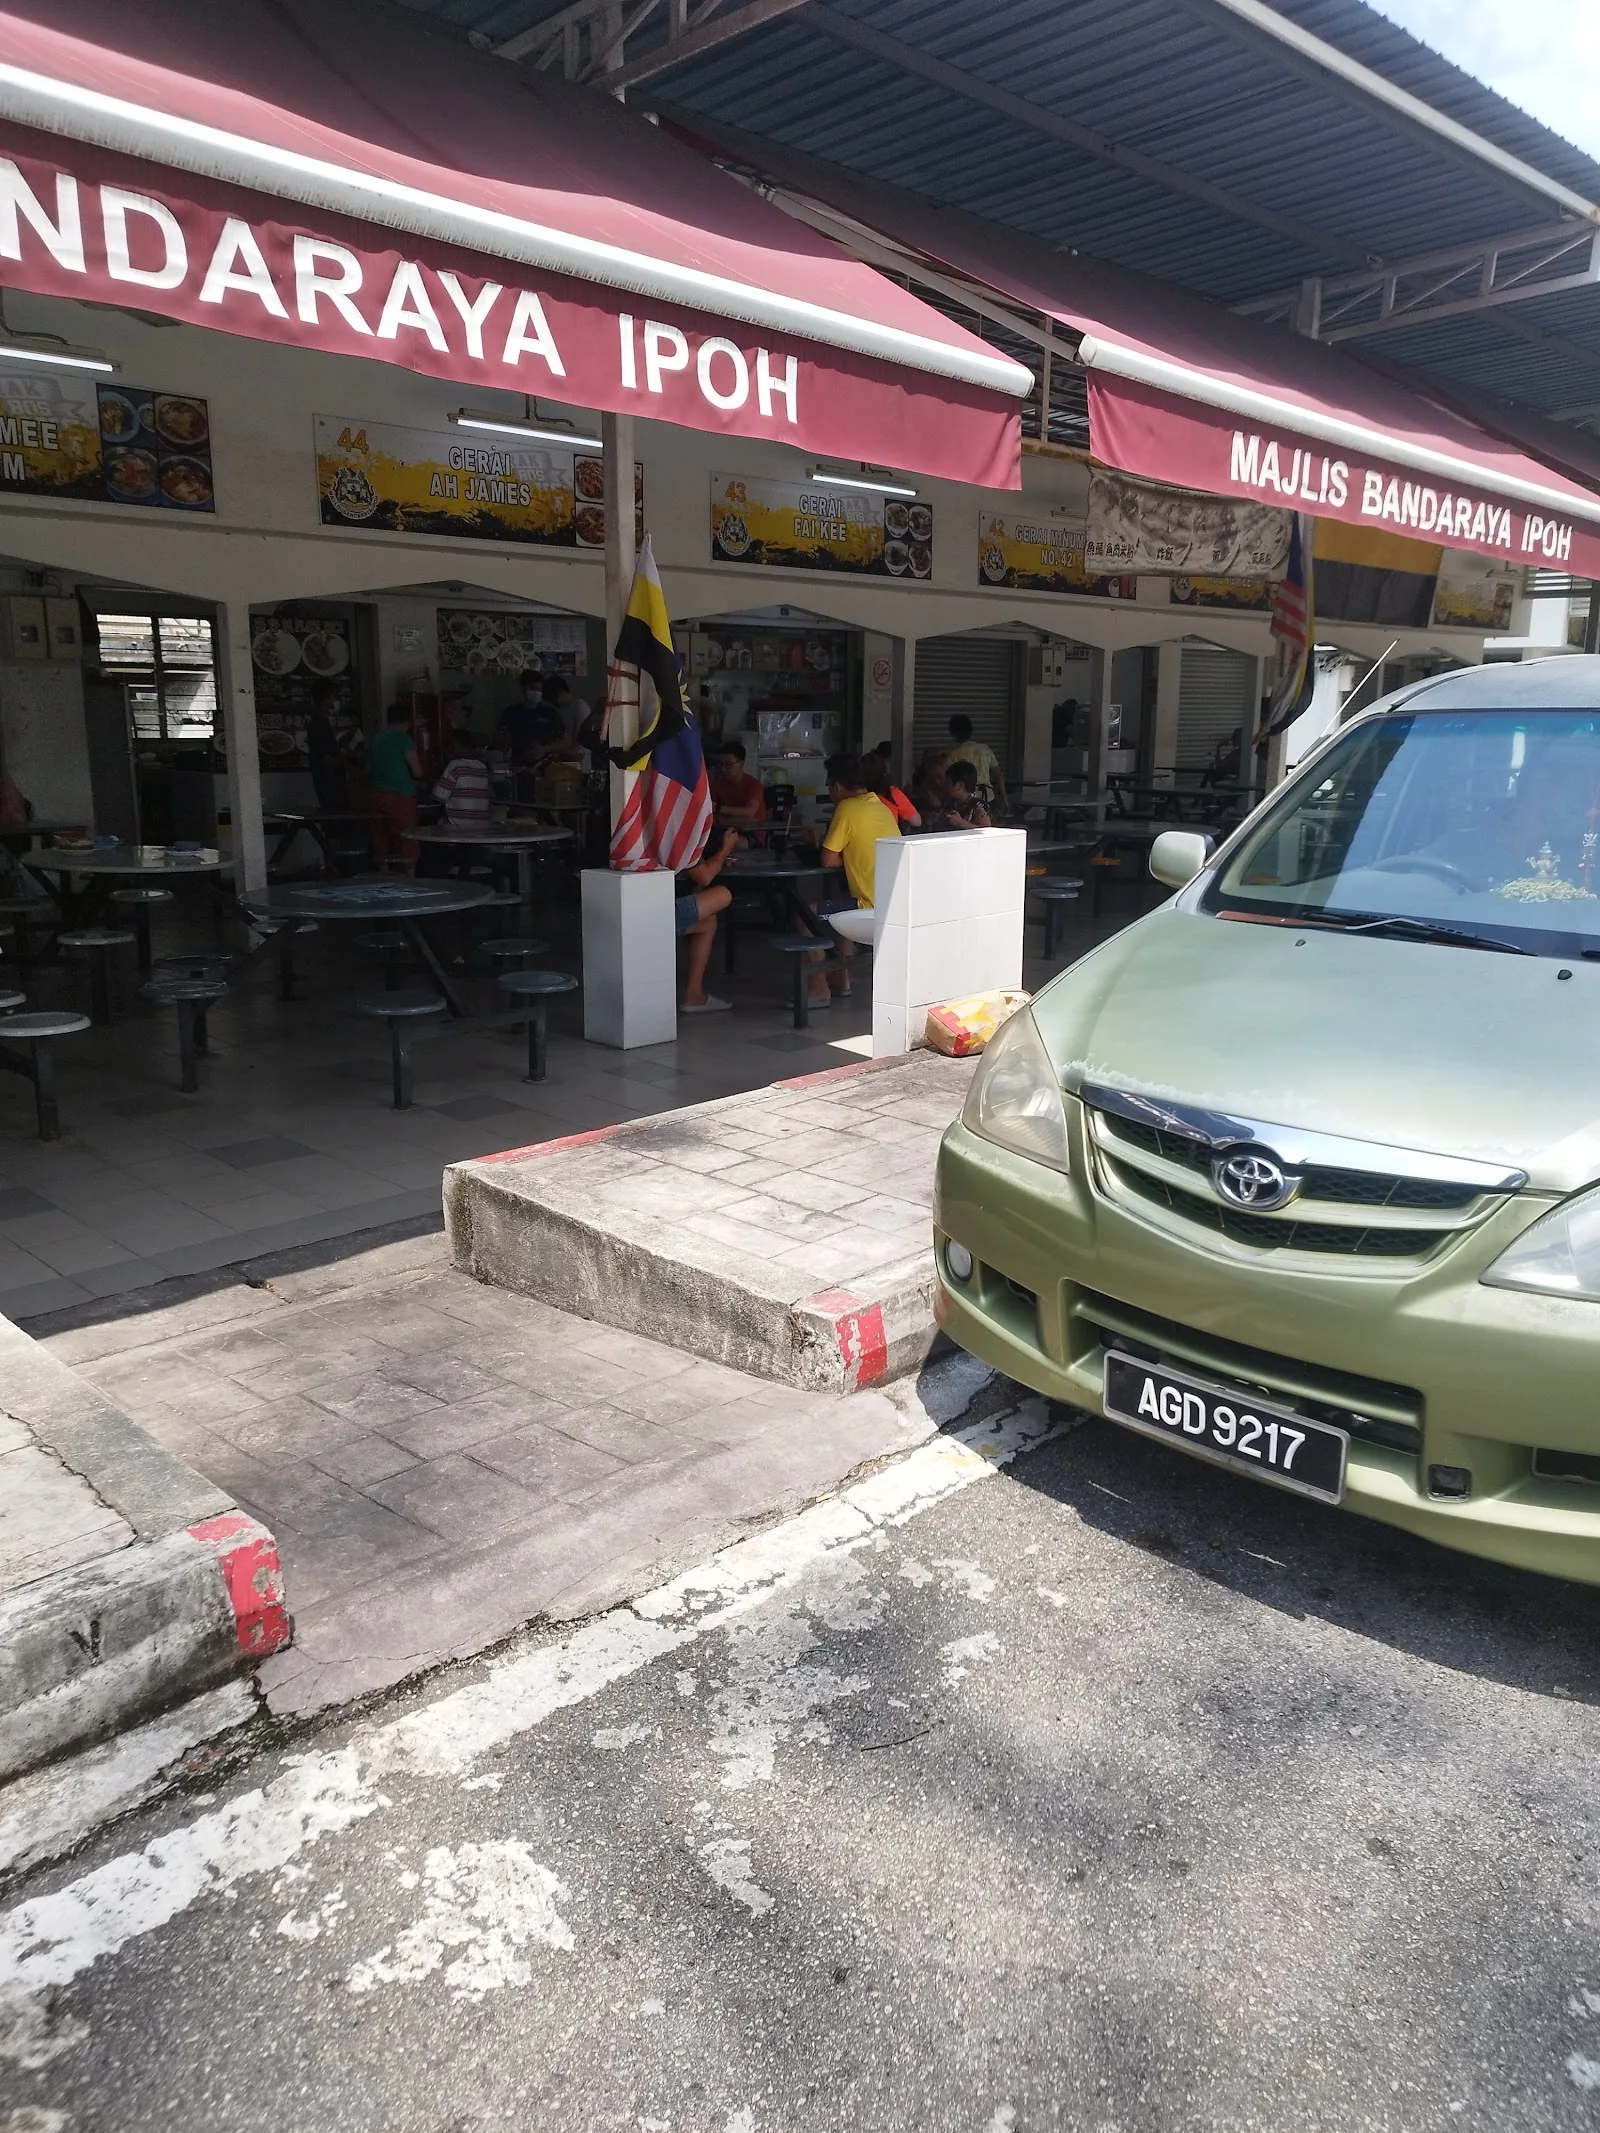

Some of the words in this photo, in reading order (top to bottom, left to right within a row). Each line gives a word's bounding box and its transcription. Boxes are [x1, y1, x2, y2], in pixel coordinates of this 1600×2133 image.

[617, 311, 799, 425] IPOH
[0, 416, 59, 450] MEE
[338, 427, 369, 454] 44
[449, 446, 511, 477] GERAI
[430, 473, 459, 499] AH
[464, 477, 531, 506] JAMES
[726, 481, 747, 503] 43
[1230, 431, 1349, 508] MAJLIS
[1361, 469, 1511, 549] BANDARAYA
[1521, 513, 1574, 562] IPOH
[799, 494, 842, 519] GERAI
[794, 517, 816, 539] FAI
[820, 520, 847, 542] KEE
[990, 518, 1005, 537] 42
[1015, 524, 1048, 545] GERAI
[1041, 549, 1058, 567] NO.
[1061, 551, 1073, 568] 42
[1137, 1377, 1206, 1435] AGD
[1212, 1405, 1306, 1470] 9217
